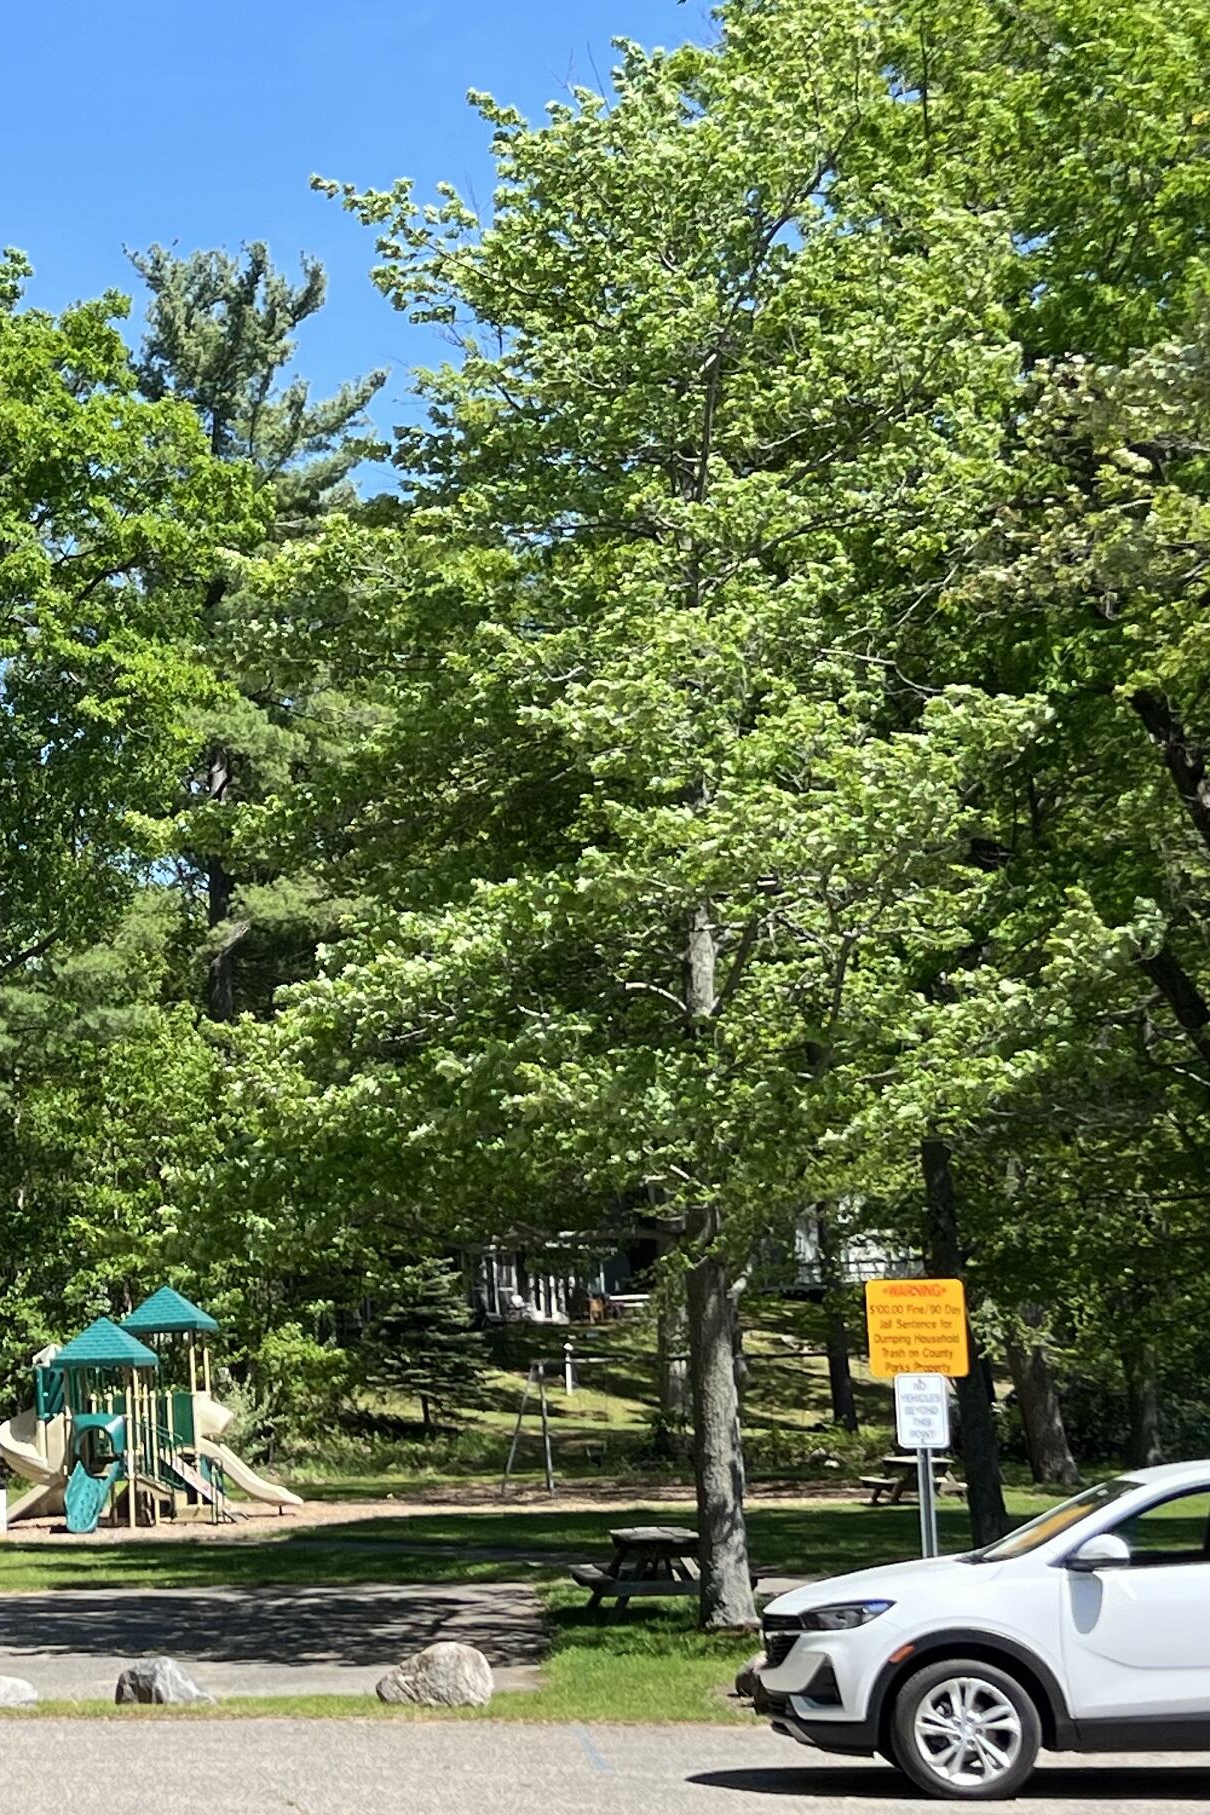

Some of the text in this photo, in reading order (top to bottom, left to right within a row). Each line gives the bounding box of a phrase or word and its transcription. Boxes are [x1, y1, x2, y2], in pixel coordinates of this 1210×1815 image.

[887, 1284, 942, 1297] WARNING
[944, 1304, 961, 1315] Day
[880, 1319, 952, 1329] Jail Sentence for
[873, 1334, 960, 1346] Dumping Household
[881, 1347, 953, 1360] Trash on County
[885, 1362, 951, 1374] Parks Property
